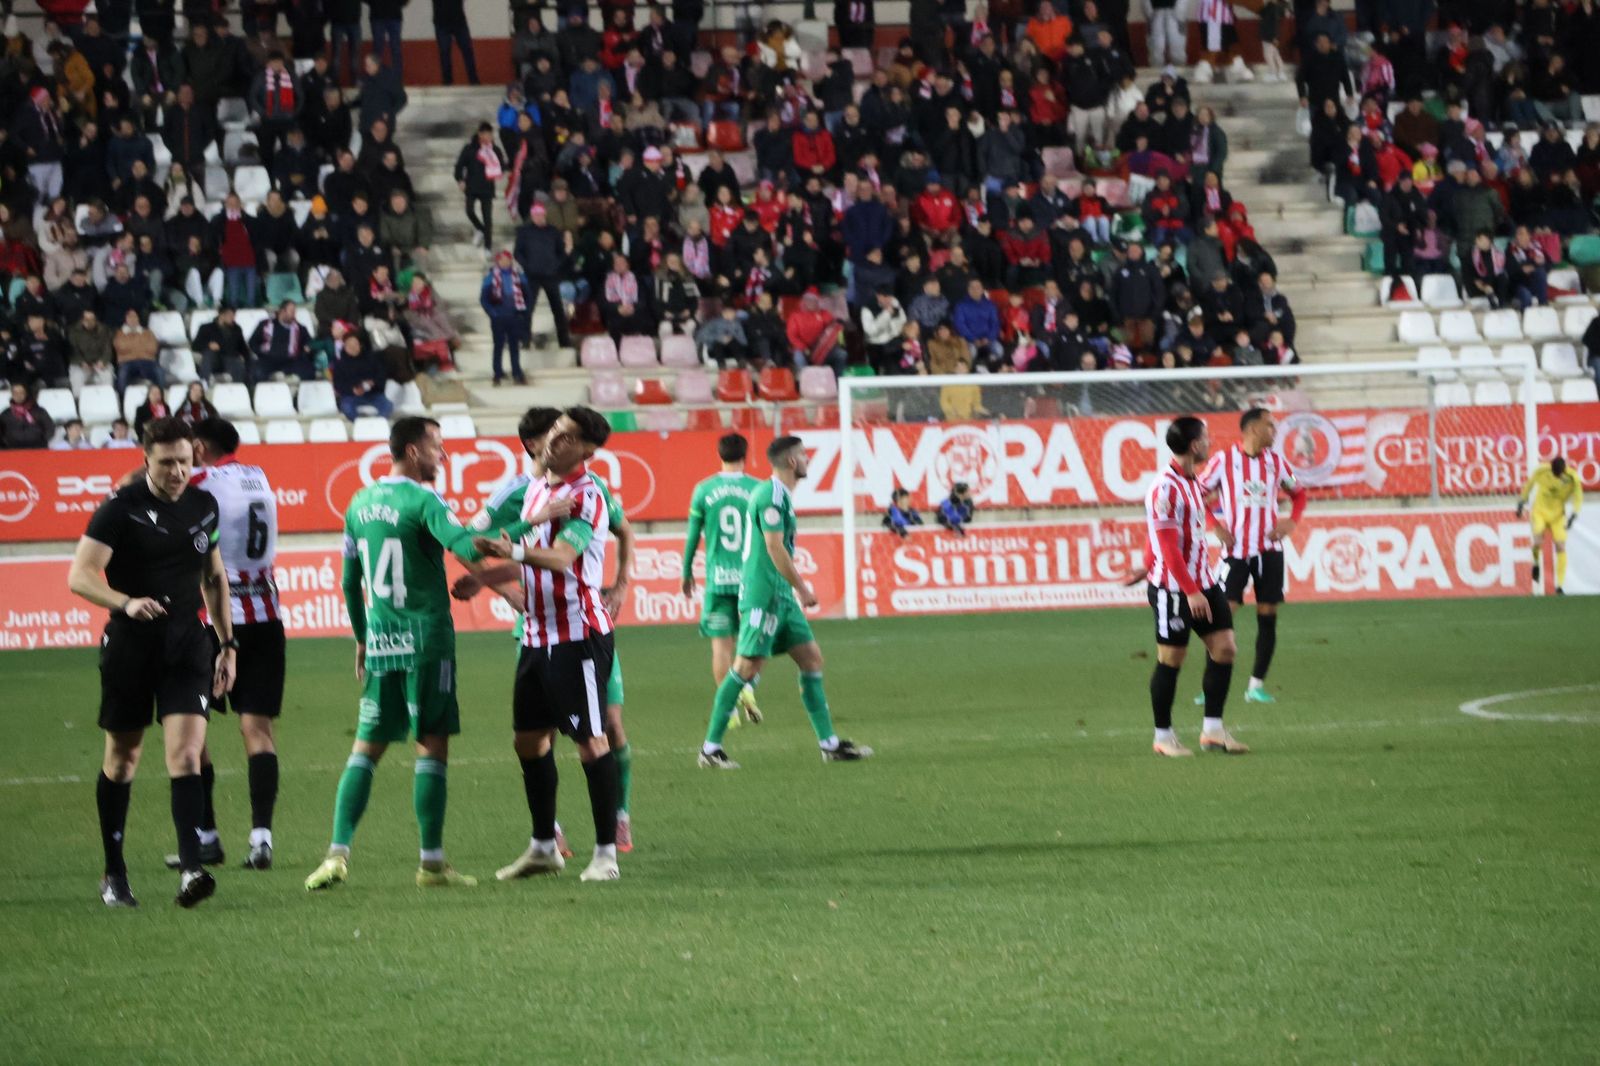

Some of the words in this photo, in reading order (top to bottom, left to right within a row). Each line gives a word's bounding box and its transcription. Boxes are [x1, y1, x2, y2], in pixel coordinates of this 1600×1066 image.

[246, 501, 269, 560] 6
[718, 504, 743, 552] 9
[933, 533, 1030, 556] bodegas
[356, 537, 408, 609] 14
[1454, 521, 1537, 589] CF
[4, 608, 61, 629] Junta
[64, 606, 92, 625] de
[25, 631, 39, 650] y
[43, 626, 93, 647] León
